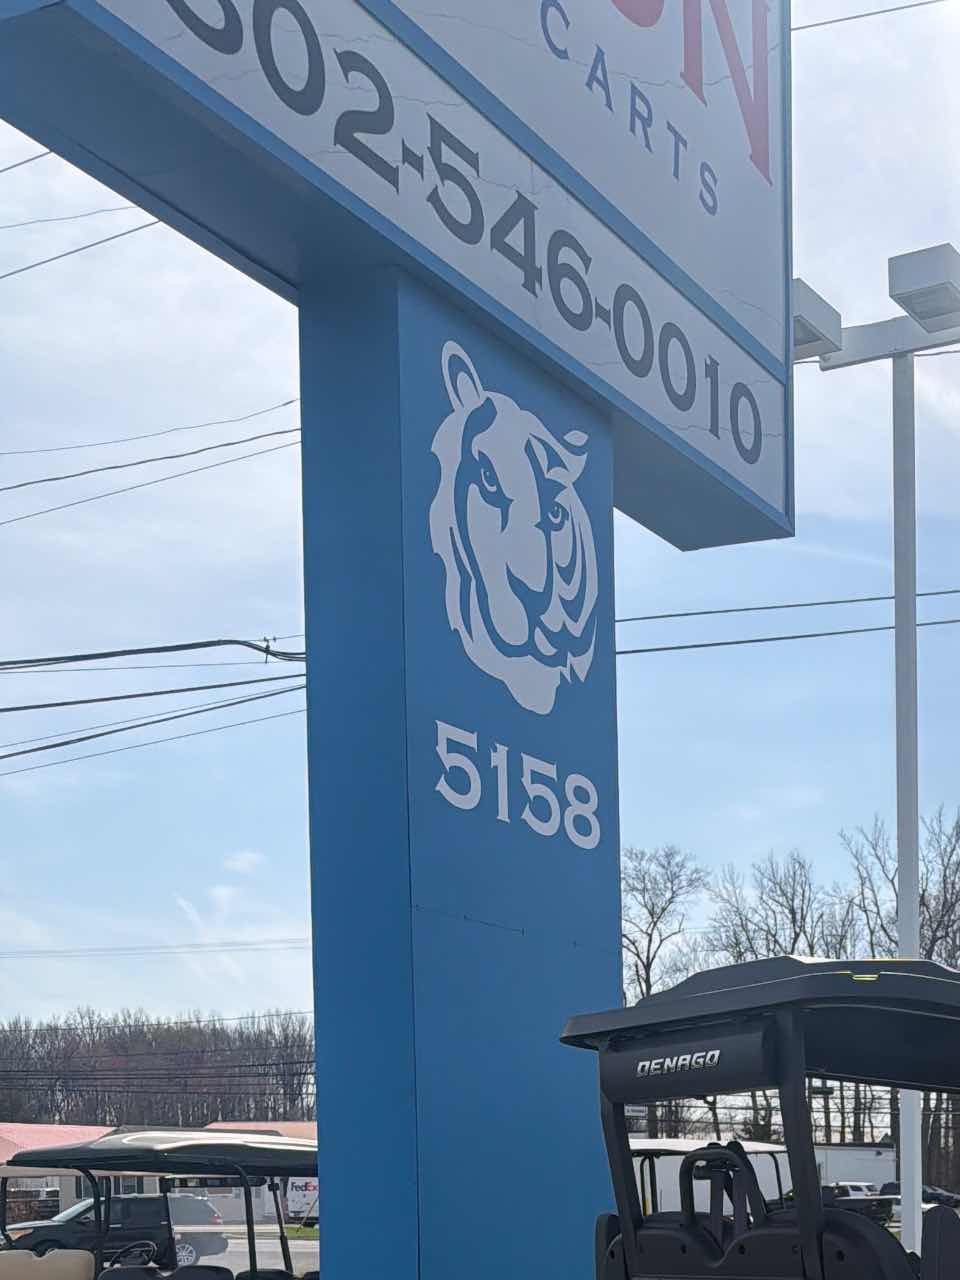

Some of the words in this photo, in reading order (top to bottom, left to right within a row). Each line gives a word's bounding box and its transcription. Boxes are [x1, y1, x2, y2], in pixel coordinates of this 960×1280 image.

[541, 0, 717, 216] CARTS
[435, 719, 601, 850] 5158
[637, 1049, 720, 1077] DENAGO
